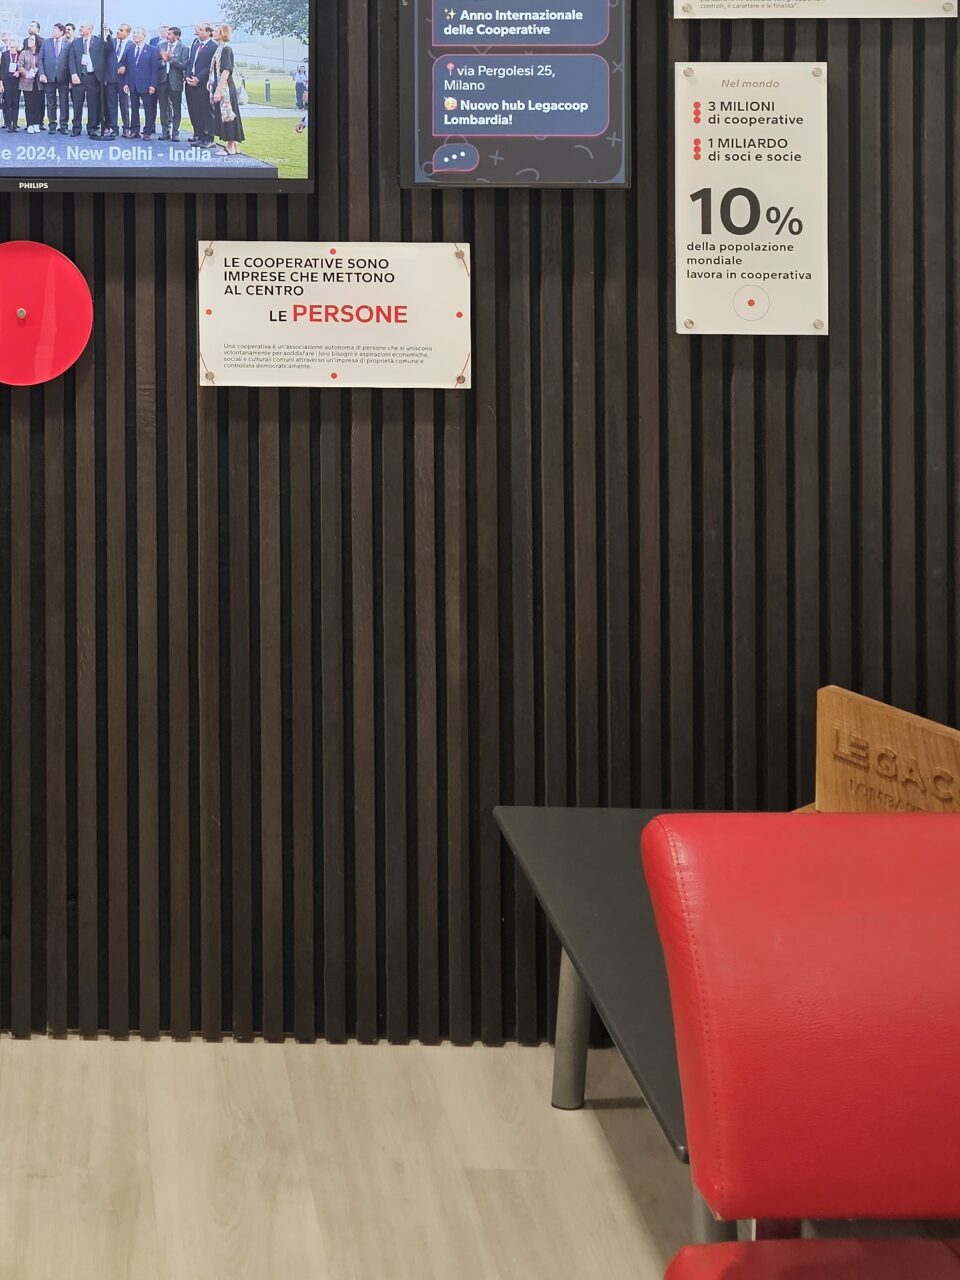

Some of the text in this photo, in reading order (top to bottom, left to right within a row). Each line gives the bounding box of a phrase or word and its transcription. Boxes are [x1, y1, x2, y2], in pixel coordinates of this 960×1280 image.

[460, 9, 583, 20] Anno Internazionale
[444, 24, 551, 37] delle Cooperative
[457, 65, 555, 78] via Pergolesi 25,
[444, 80, 485, 90] Milano
[721, 79, 780, 88] Nel mondo
[460, 100, 588, 113] Nuovo hub Legacoop
[708, 101, 774, 111] 3 MILIONI
[444, 114, 512, 125] Lombardia!
[708, 114, 803, 126] di cooperative
[708, 138, 788, 148] 1 MILIARDO
[16, 146, 61, 162] 2024,
[66, 146, 104, 161] New
[109, 146, 152, 161] Delhi
[169, 146, 211, 161] India
[708, 151, 720, 161] di
[725, 151, 751, 161] soci
[767, 151, 801, 161] socie
[18, 182, 49, 190] PHILIPS
[690, 187, 803, 235] 10%
[687, 242, 794, 253] della popolazione
[224, 257, 389, 269] LE COOPERATIVE SONO
[687, 256, 742, 265] mondiale
[224, 271, 395, 283] IMPRESE CHE METTONO
[687, 269, 811, 281] lavora in cooperativa
[224, 285, 304, 296] AL CENTRO
[270, 304, 407, 323] LE PERSONE
[833, 727, 959, 802] LEGAC
